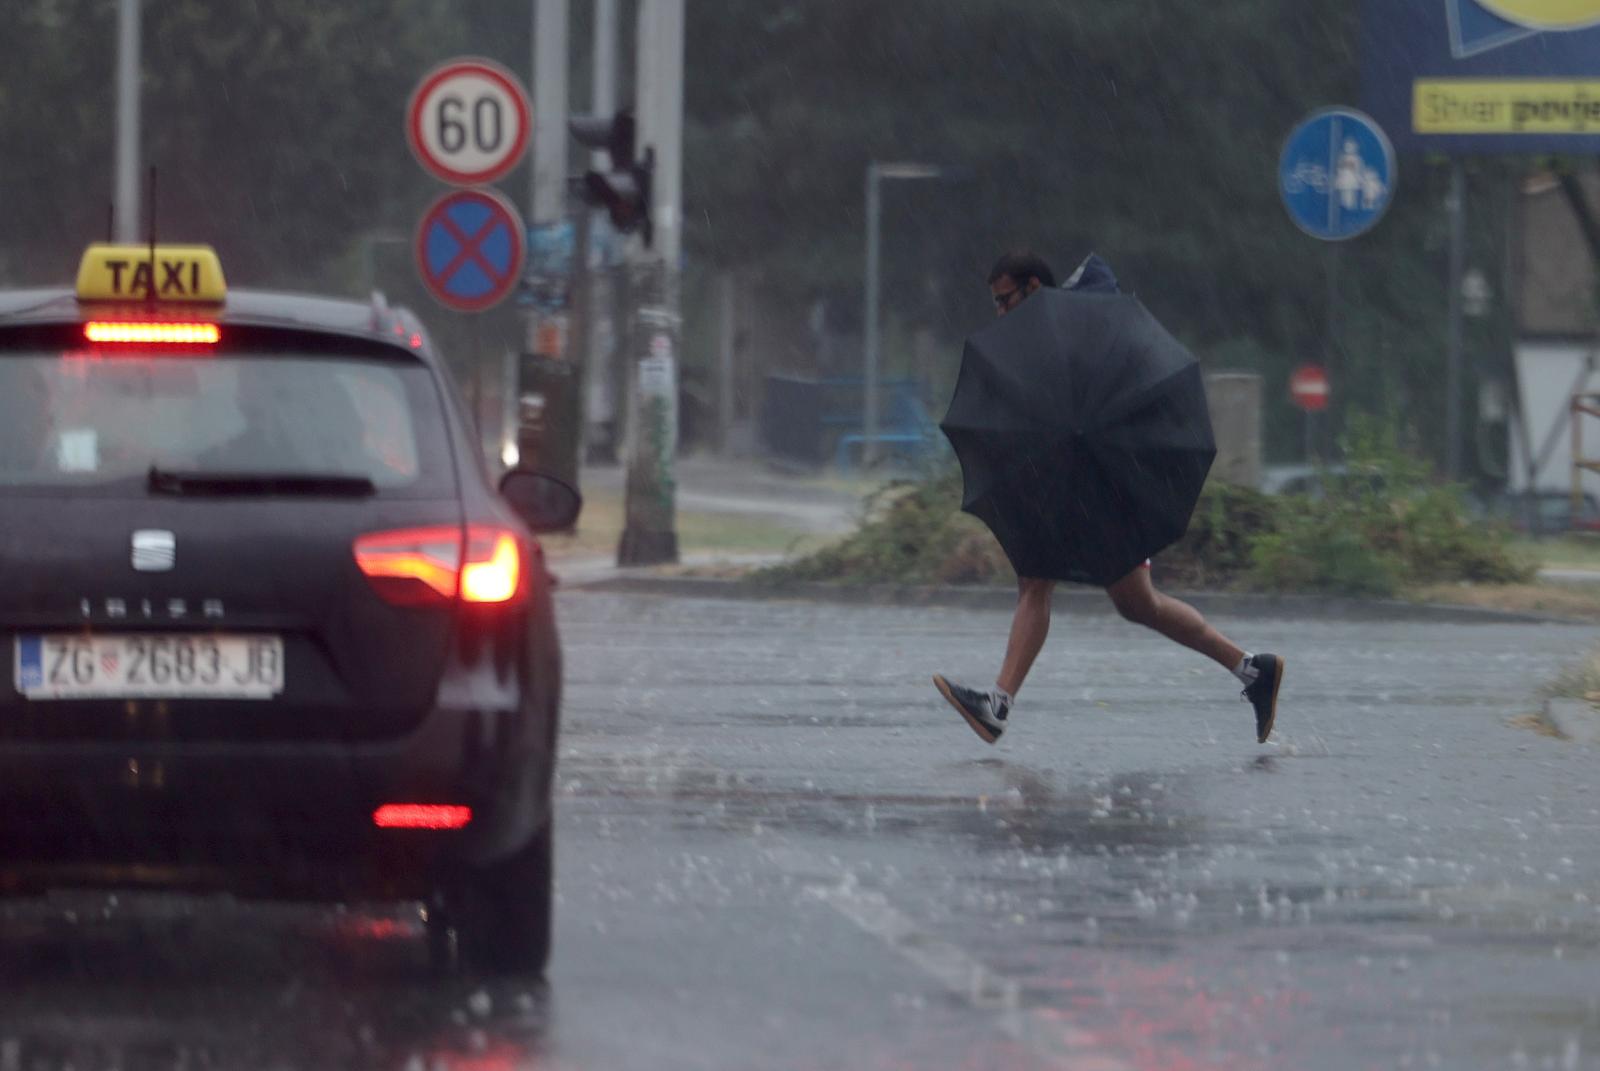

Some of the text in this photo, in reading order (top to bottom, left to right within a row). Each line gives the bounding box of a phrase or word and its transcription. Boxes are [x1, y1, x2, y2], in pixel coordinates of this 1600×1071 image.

[437, 97, 503, 154] 60
[106, 260, 200, 295] TAXI
[49, 636, 95, 685] ZG
